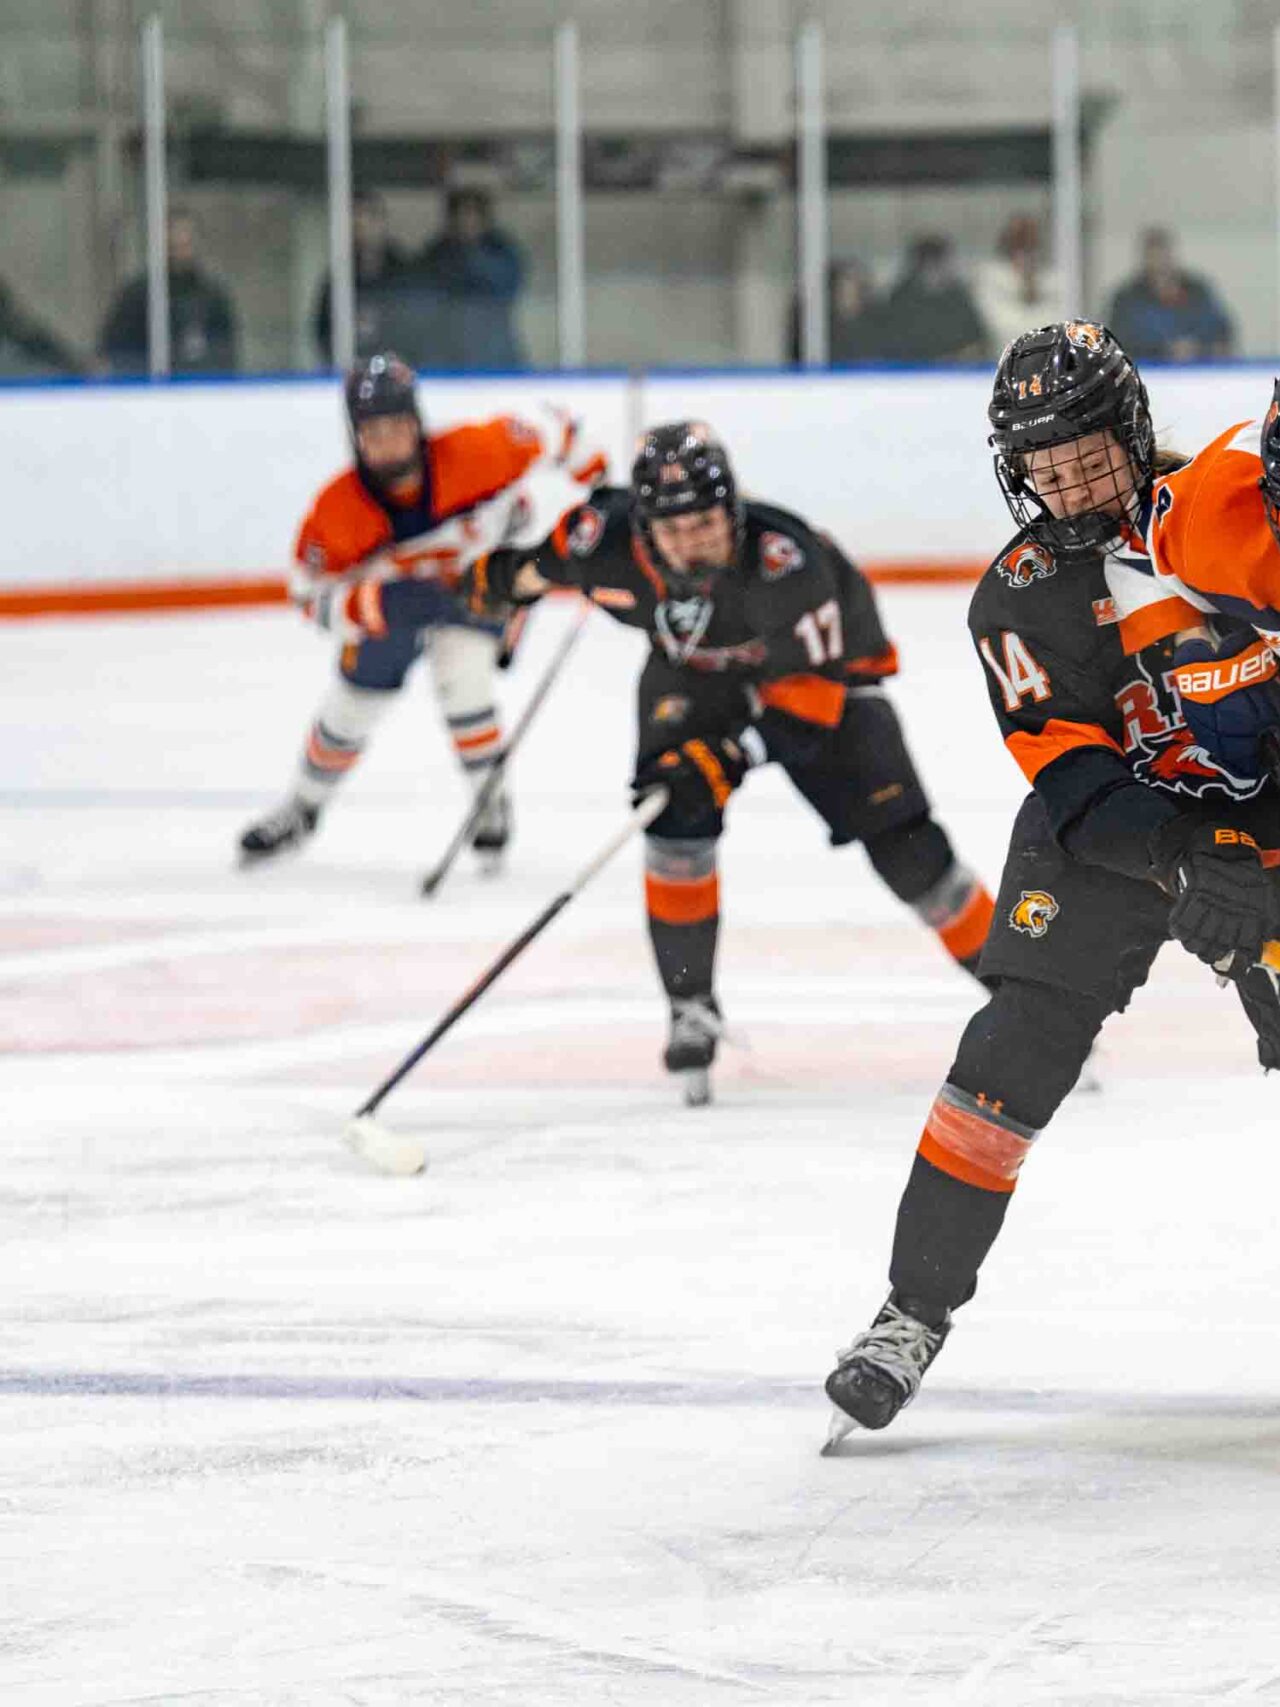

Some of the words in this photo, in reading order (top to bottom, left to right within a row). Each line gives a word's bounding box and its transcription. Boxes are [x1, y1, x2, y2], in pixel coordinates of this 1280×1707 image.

[1018, 374, 1042, 400] 14
[794, 599, 845, 666] 17
[979, 630, 1052, 712] 14
